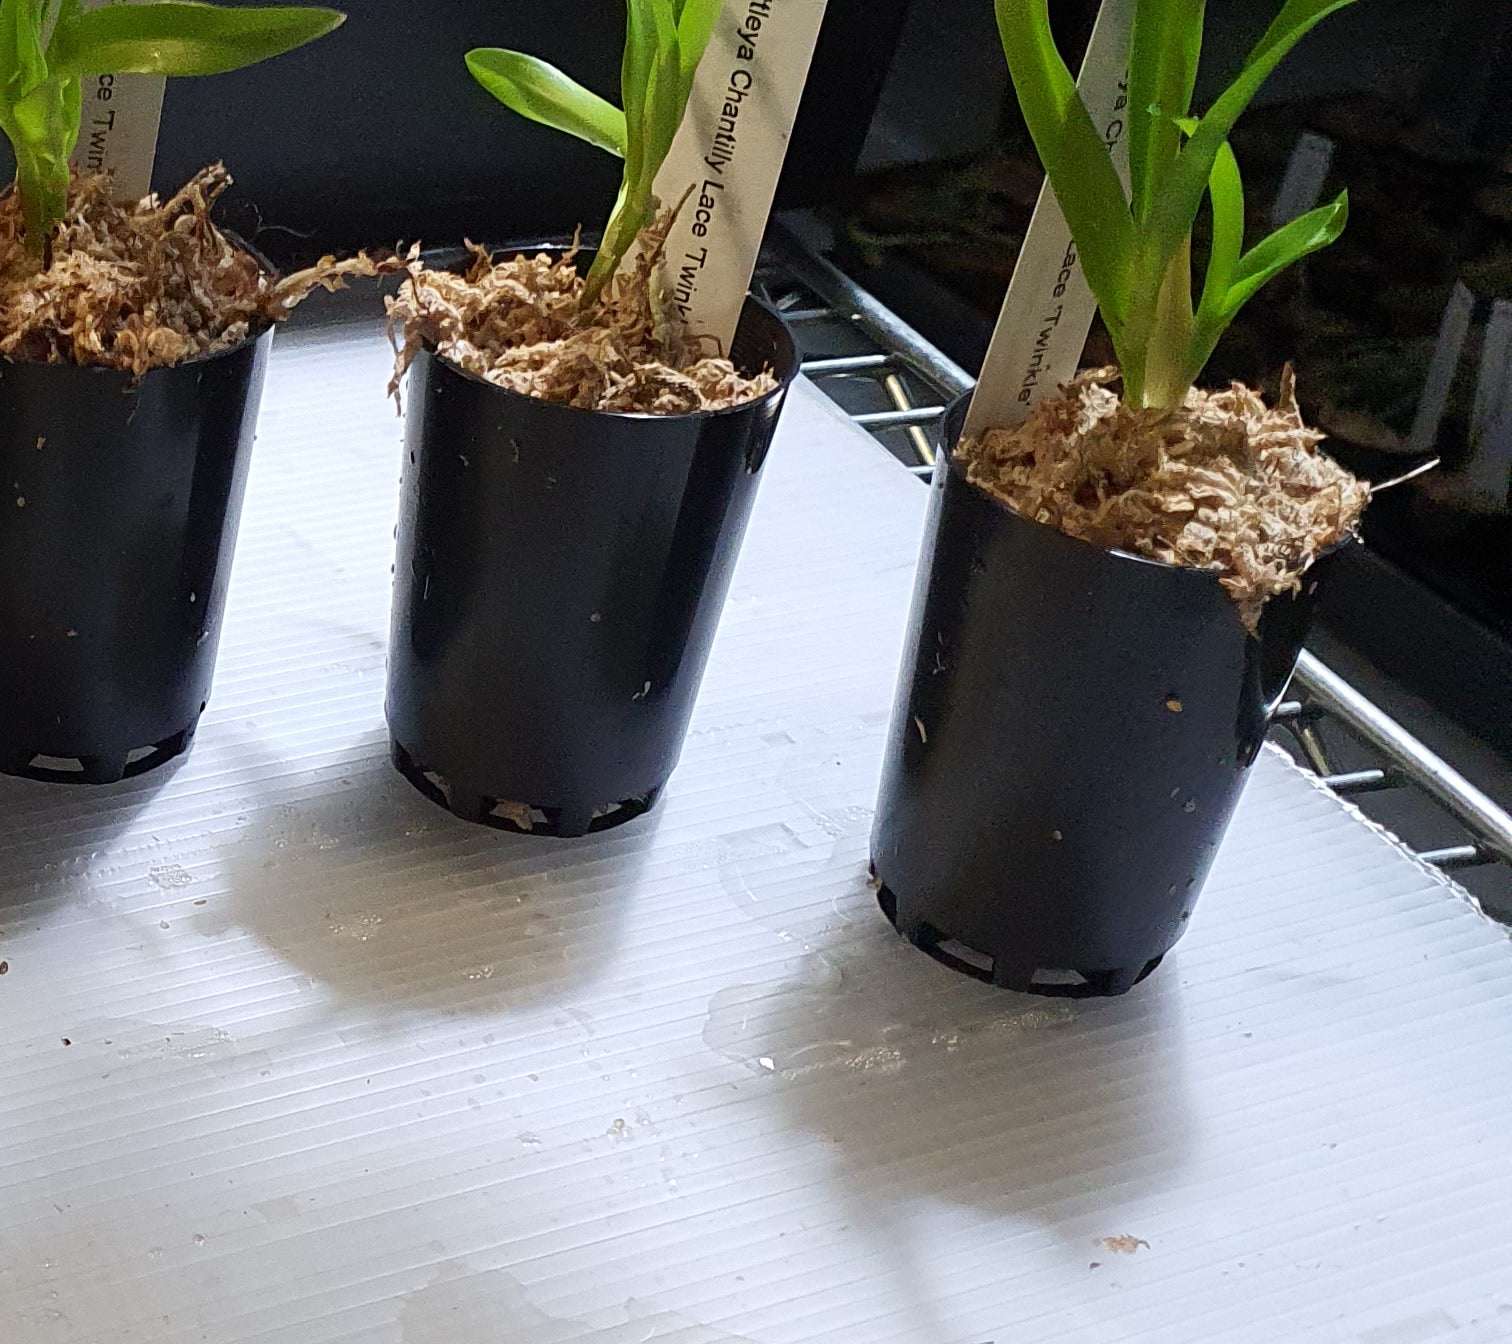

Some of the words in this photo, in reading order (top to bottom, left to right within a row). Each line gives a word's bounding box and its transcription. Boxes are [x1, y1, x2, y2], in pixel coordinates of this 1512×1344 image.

[704, 68, 754, 177] Chantilly
[692, 179, 724, 238] Lace
[674, 248, 707, 324] 'Twink
